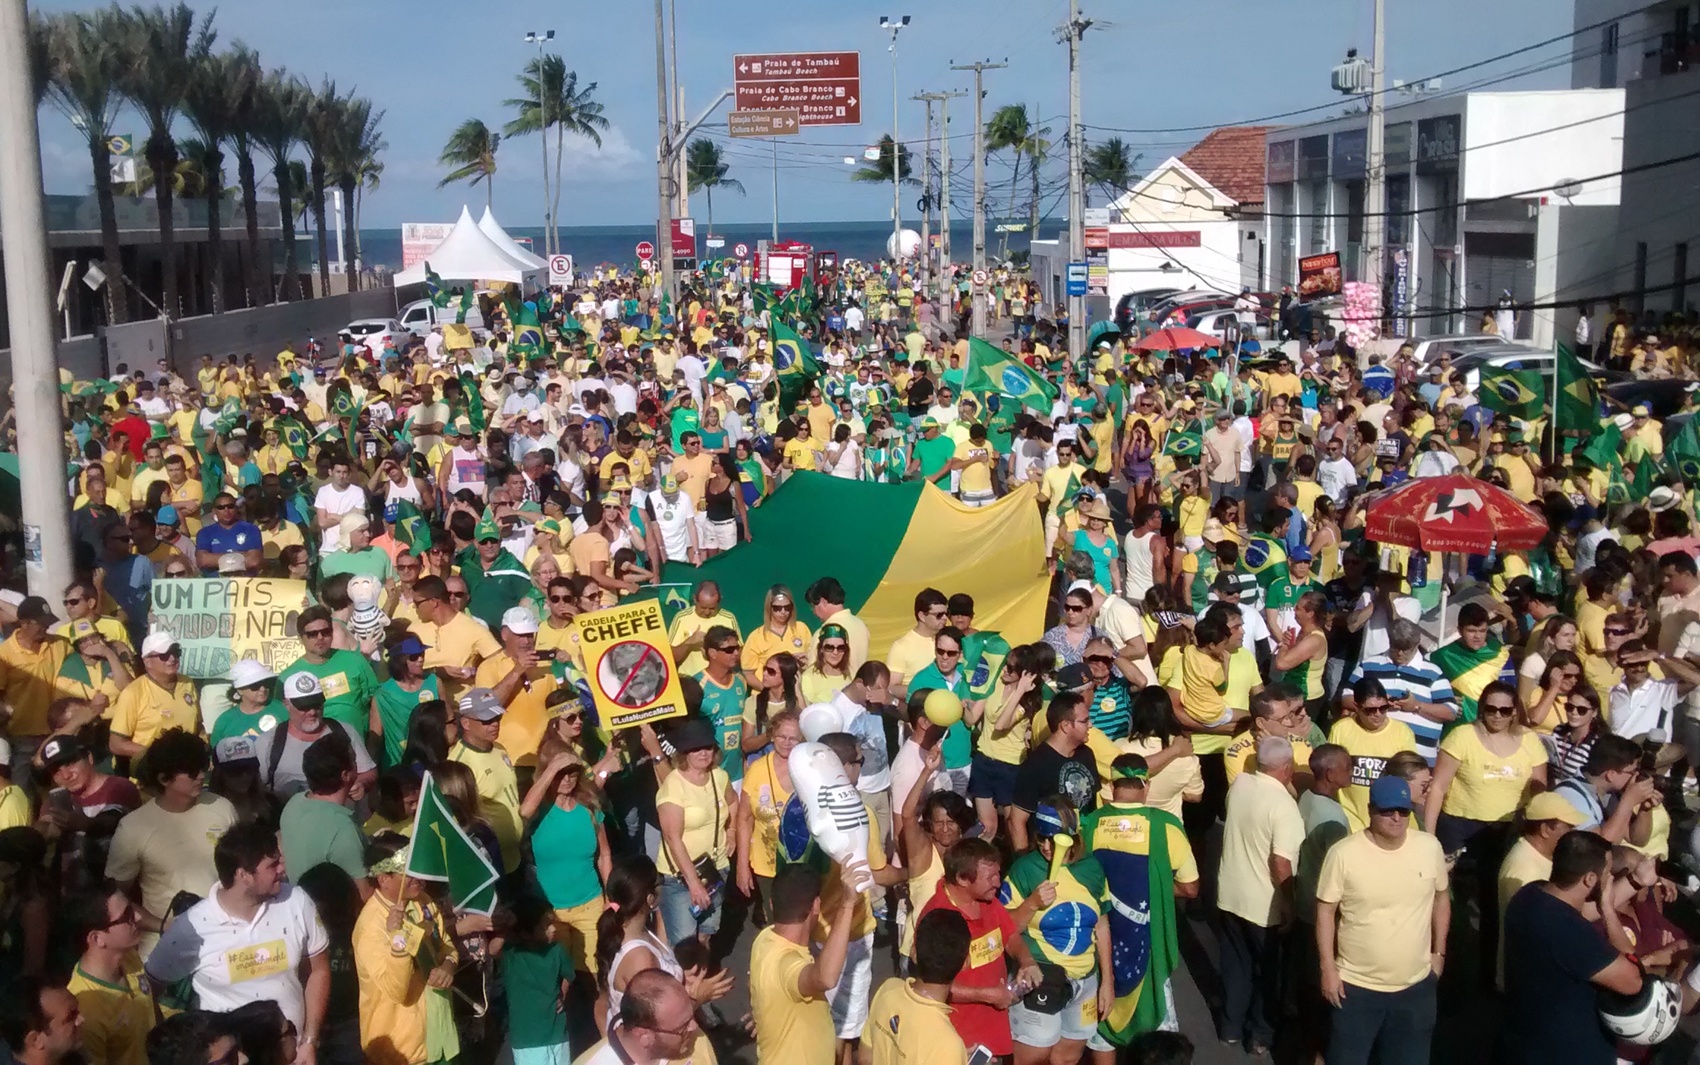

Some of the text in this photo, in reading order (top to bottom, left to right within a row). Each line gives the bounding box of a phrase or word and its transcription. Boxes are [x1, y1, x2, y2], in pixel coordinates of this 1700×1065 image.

[806, 58, 840, 66] Tambaú
[155, 578, 272, 609] UM PAÍS
[1284, 586, 1292, 597] 9
[246, 604, 300, 638] NÃO
[580, 615, 616, 628] CADEIA
[619, 609, 646, 620] PARA
[583, 614, 661, 643] CHEFE
[274, 650, 298, 659] PRA
[612, 705, 675, 725] #LulaNuncaMais
[1227, 738, 1252, 758] Itaú
[504, 784, 519, 807] 11
[1116, 901, 1120, 909] E
